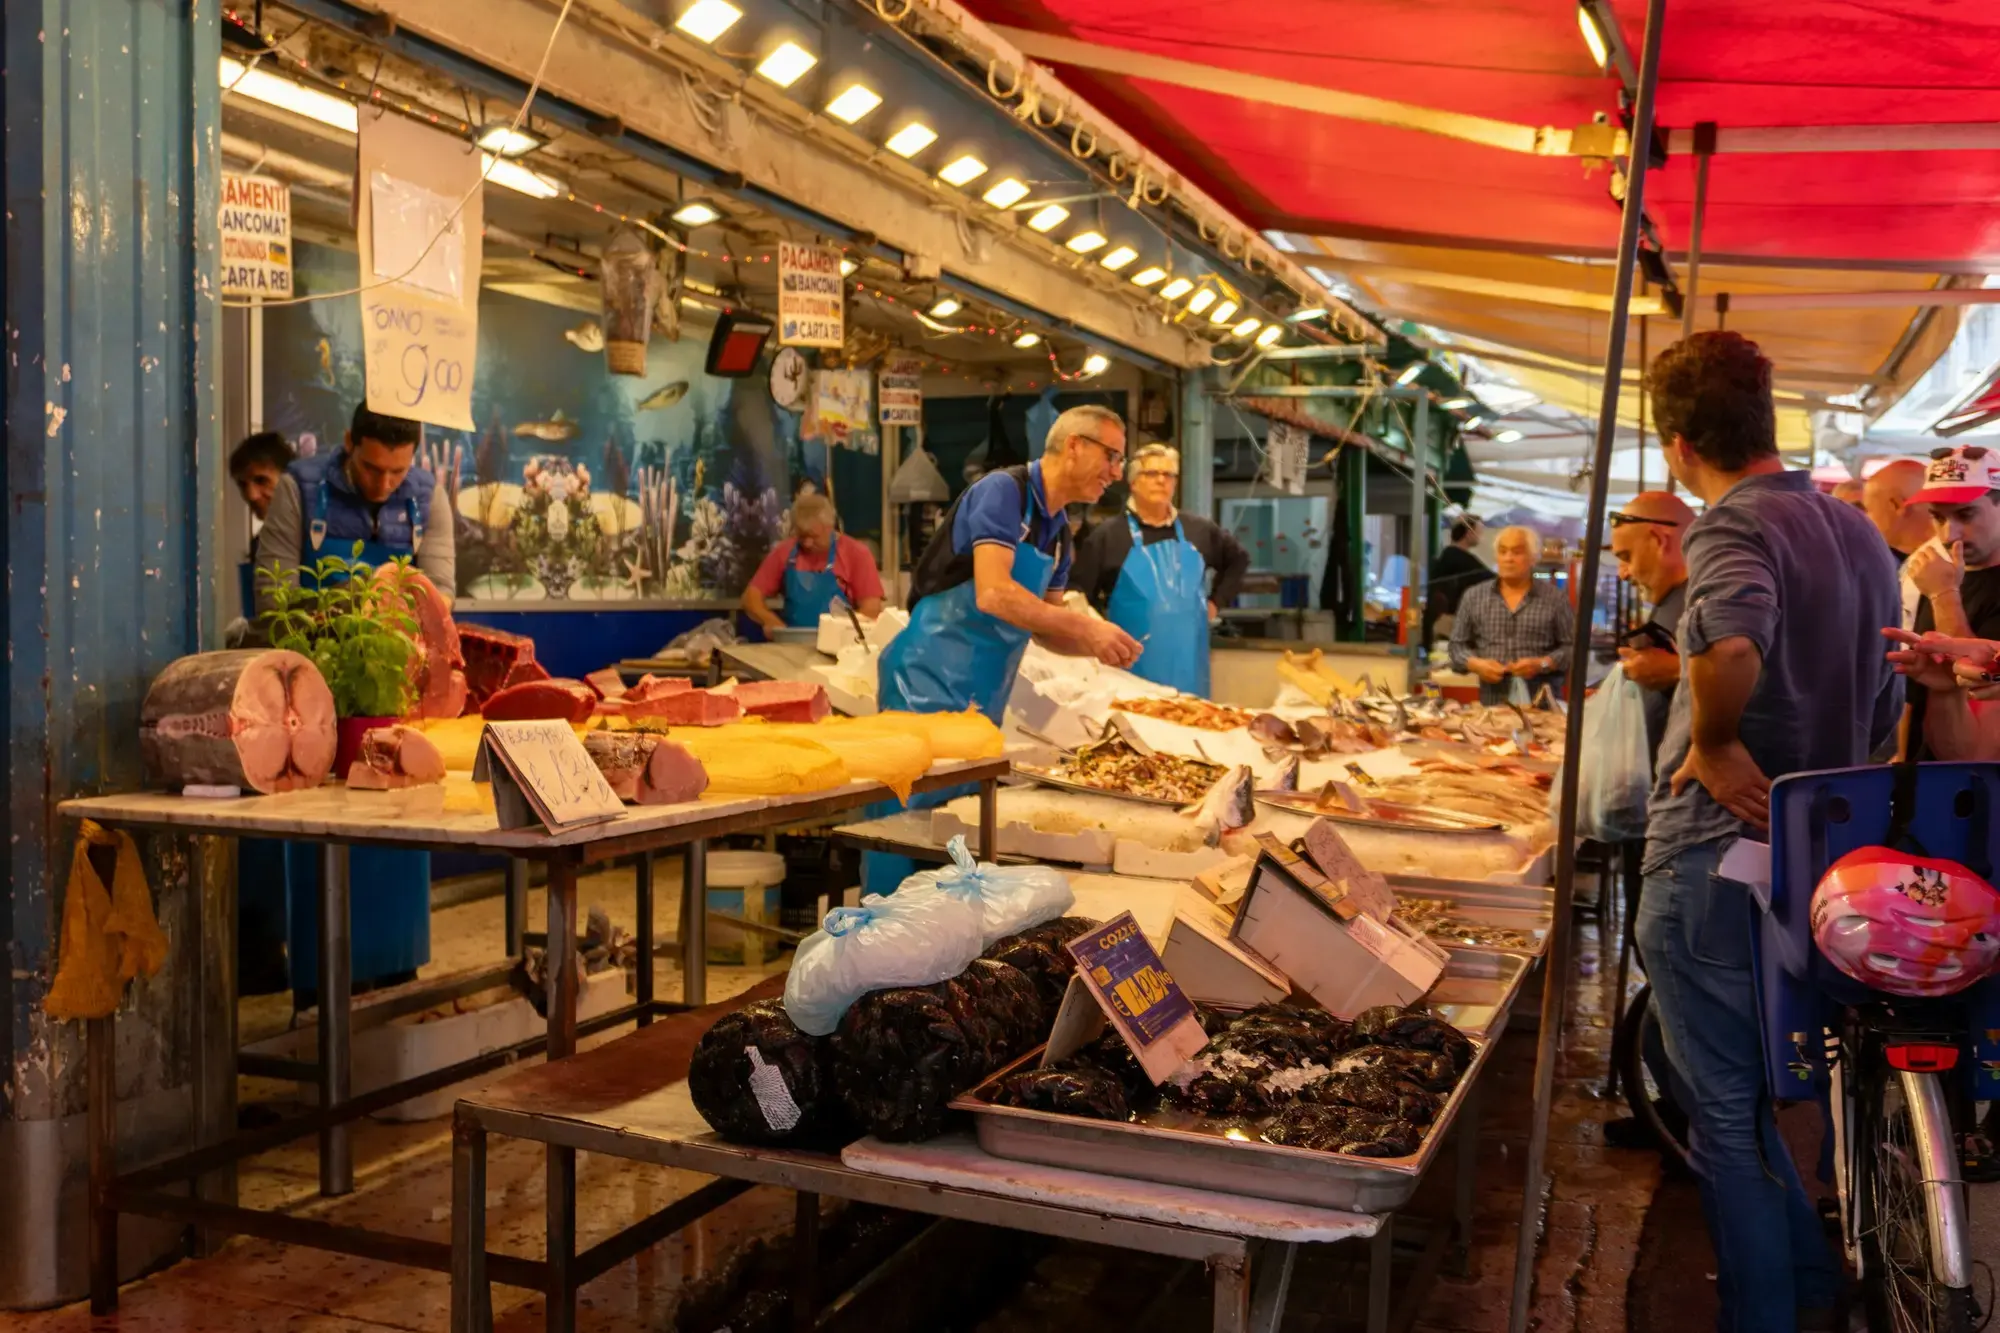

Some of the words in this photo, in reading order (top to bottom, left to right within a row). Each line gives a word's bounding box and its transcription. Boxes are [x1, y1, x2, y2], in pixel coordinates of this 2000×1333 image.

[222, 208, 287, 237] ANCOMAT
[366, 303, 423, 336] TONNO
[799, 319, 829, 340] CARTA
[1099, 921, 1139, 950] COZZE
